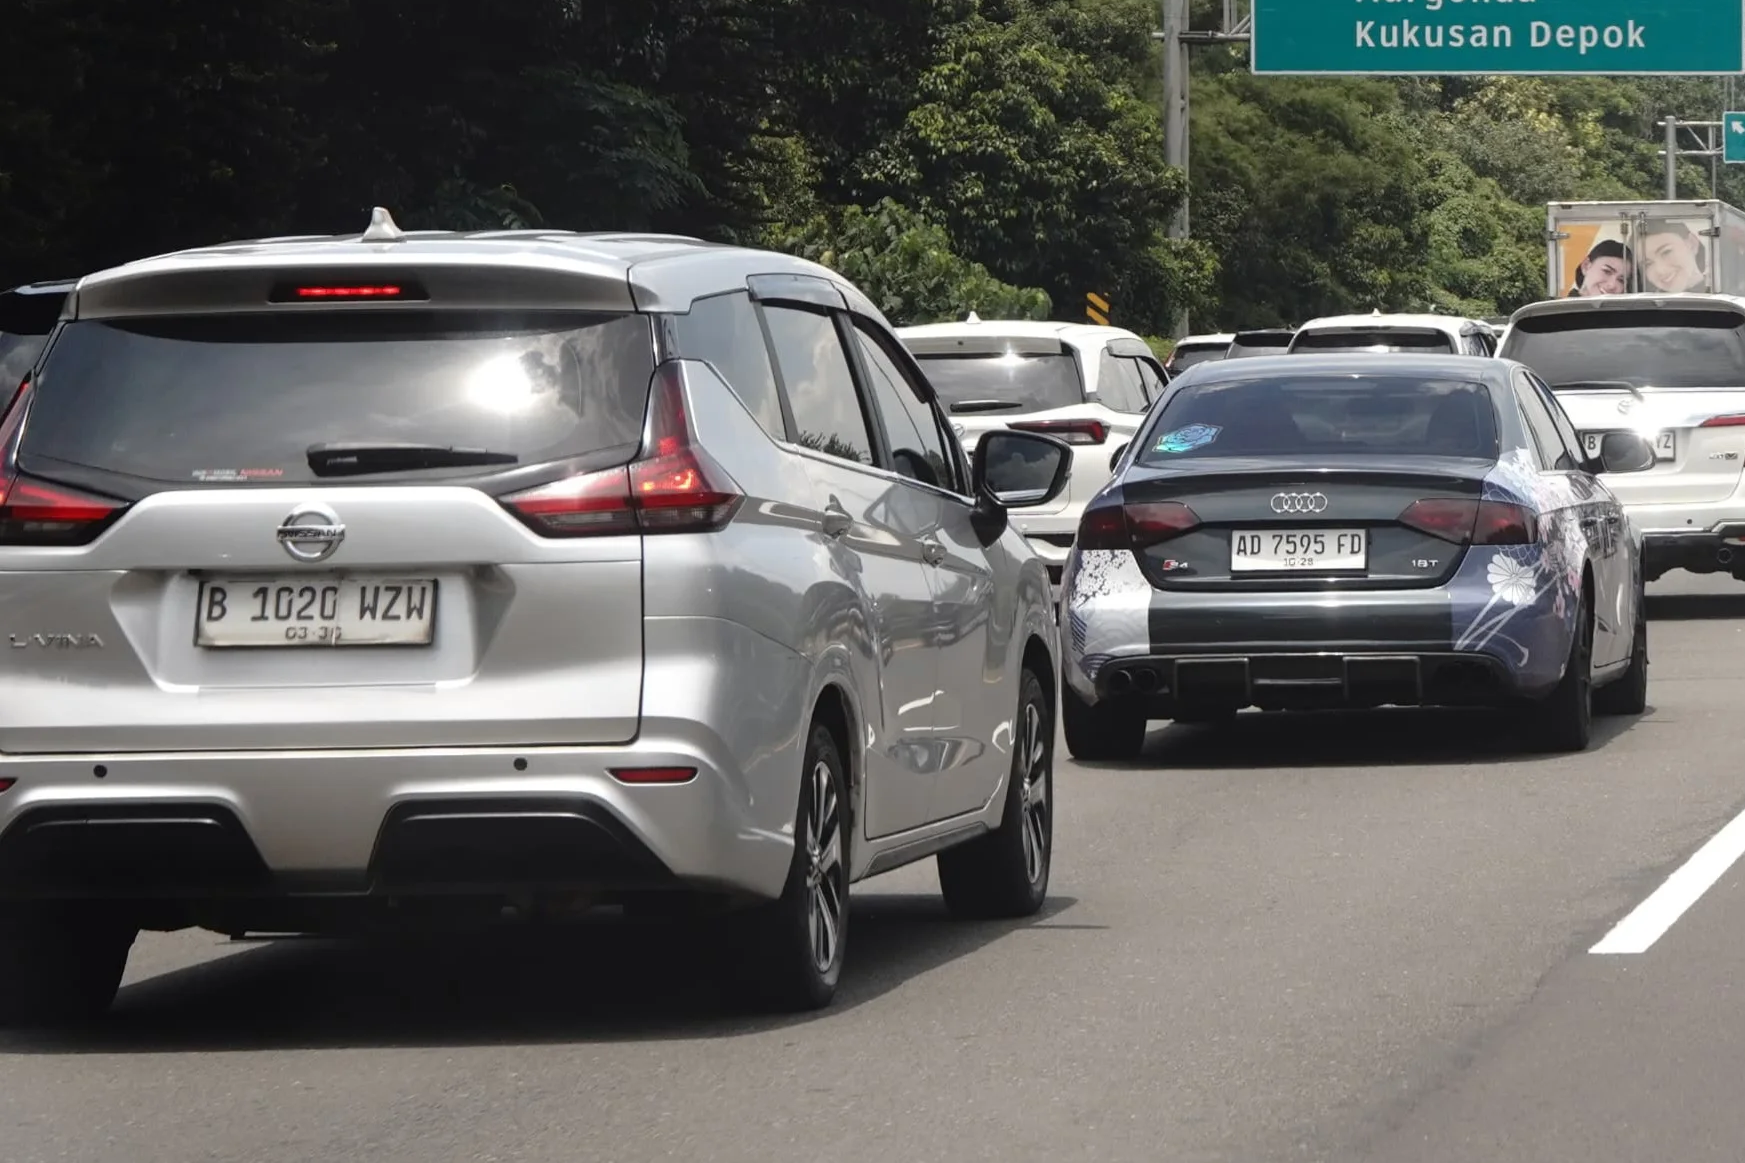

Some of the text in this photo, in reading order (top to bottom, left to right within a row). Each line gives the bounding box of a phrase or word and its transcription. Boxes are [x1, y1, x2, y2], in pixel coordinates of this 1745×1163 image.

[1355, 19, 1646, 55] Kukusan Depok
[1236, 533, 1361, 556] AD 7595 FD
[206, 585, 428, 623] B 1020 WZW
